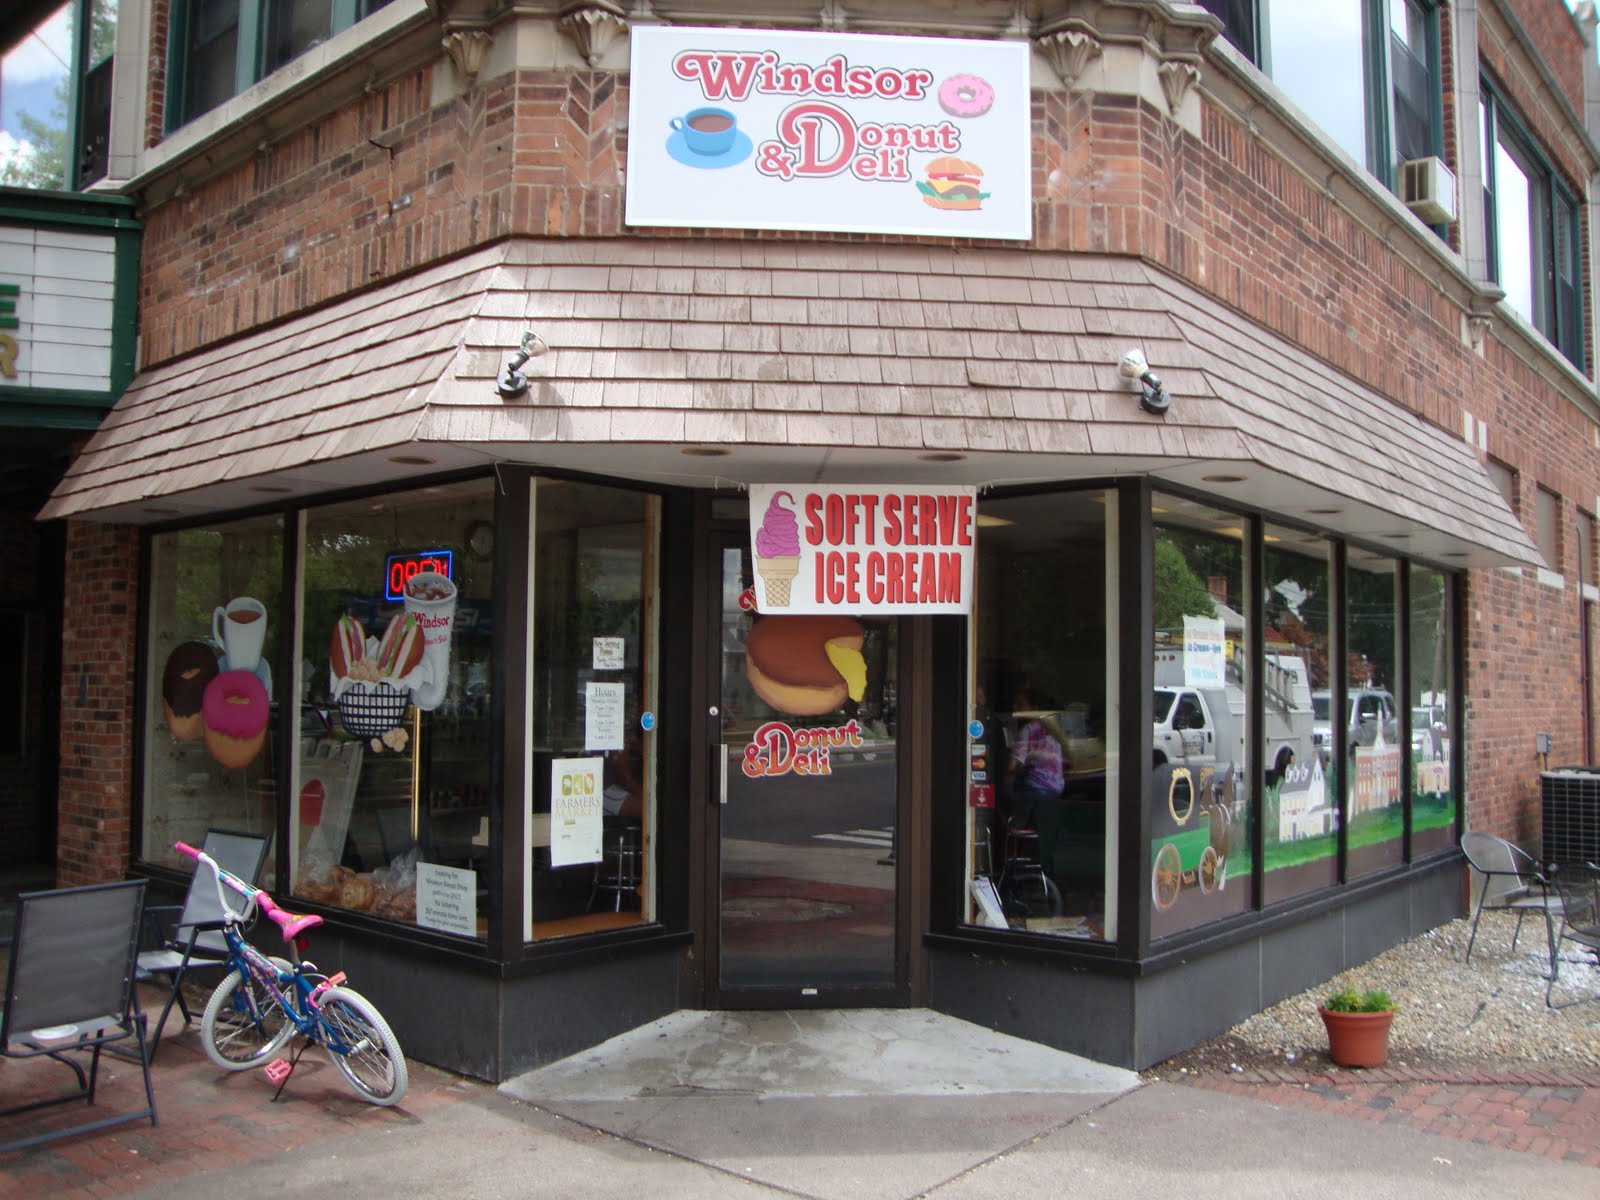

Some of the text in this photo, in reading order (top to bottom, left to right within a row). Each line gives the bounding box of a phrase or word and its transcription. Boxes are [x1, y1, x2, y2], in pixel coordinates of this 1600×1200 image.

[673, 51, 931, 99] Windsor
[780, 102, 960, 176] Donut
[804, 493, 973, 546] SOFT SERVE
[814, 551, 861, 604] ICE
[866, 551, 962, 604] CREAM
[411, 612, 450, 628] Windsor
[594, 687, 616, 697] Hours
[755, 720, 863, 775] Donut
[555, 796, 601, 809] FARMERS
[555, 805, 599, 818] MARKET
